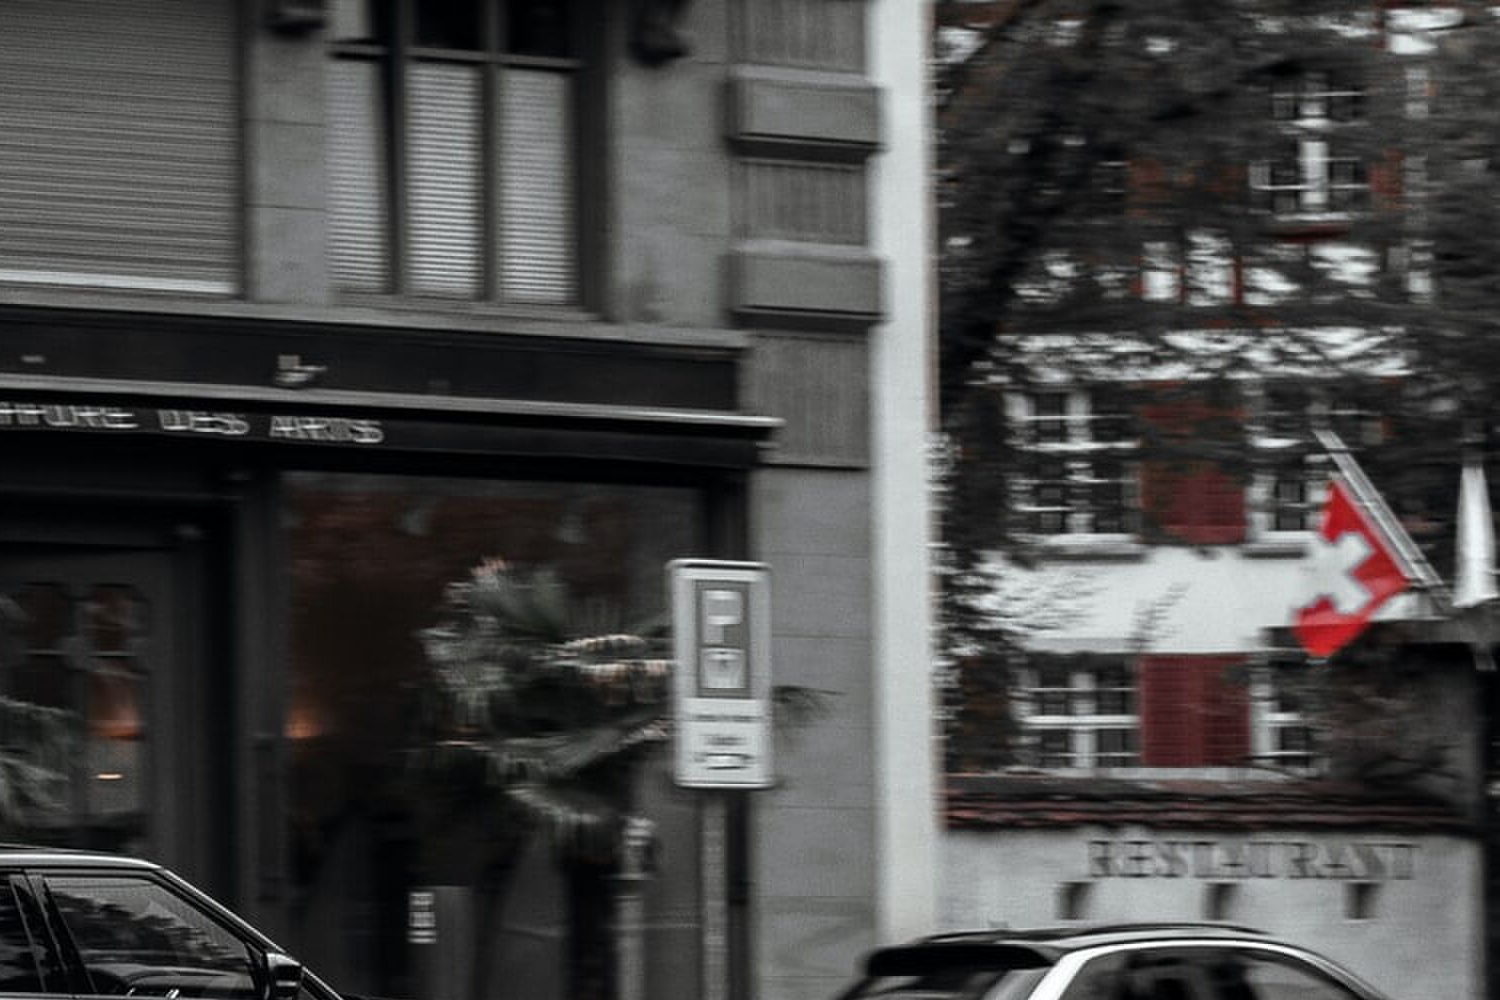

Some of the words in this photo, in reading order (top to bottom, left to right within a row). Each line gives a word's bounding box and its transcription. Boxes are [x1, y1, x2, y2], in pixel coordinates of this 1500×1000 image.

[158, 409, 250, 435] DES
[269, 415, 384, 444] ARTS
[701, 589, 743, 643] P
[1086, 839, 1418, 880] RESTAURANT
